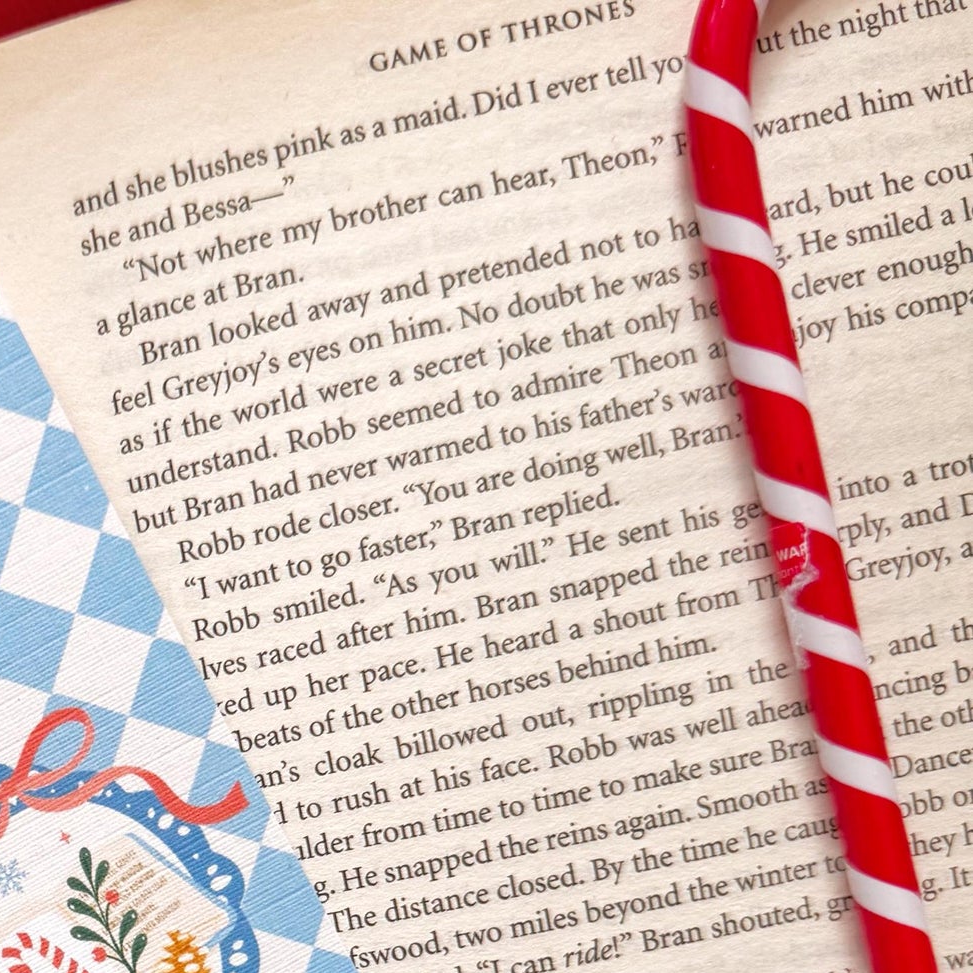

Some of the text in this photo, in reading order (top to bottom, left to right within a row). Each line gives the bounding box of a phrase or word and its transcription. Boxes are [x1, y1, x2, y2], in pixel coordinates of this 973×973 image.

[369, 0, 635, 72] GAME OF THRONES
[72, 0, 967, 217] and she blushes pink as a maid. Did I ever tell the night that
[193, 231, 273, 265] where
[281, 217, 323, 245] my
[328, 193, 428, 232] brother
[437, 182, 485, 207] can
[490, 167, 557, 196] hear,
[754, 95, 853, 139] warned
[857, 88, 915, 117] him
[791, 239, 973, 300] clever enough
[111, 380, 156, 416] feel
[287, 341, 342, 374] eyes
[348, 331, 384, 354] on
[388, 316, 452, 345] him.
[456, 301, 500, 330] No
[507, 282, 587, 319] doubt
[590, 274, 626, 301] he
[630, 266, 681, 292] was
[796, 228, 839, 257] He
[845, 204, 934, 247] smiled
[940, 208, 957, 227] a
[178, 526, 246, 564] Robb
[251, 511, 312, 546] rode
[318, 496, 400, 530] closer.
[475, 470, 516, 494] are
[522, 451, 601, 483] doing
[602, 431, 666, 465] well,
[837, 469, 919, 501] into a
[845, 546, 952, 581] Greyjoy,
[638, 926, 706, 953] Bran
[710, 895, 821, 939] shouted,
